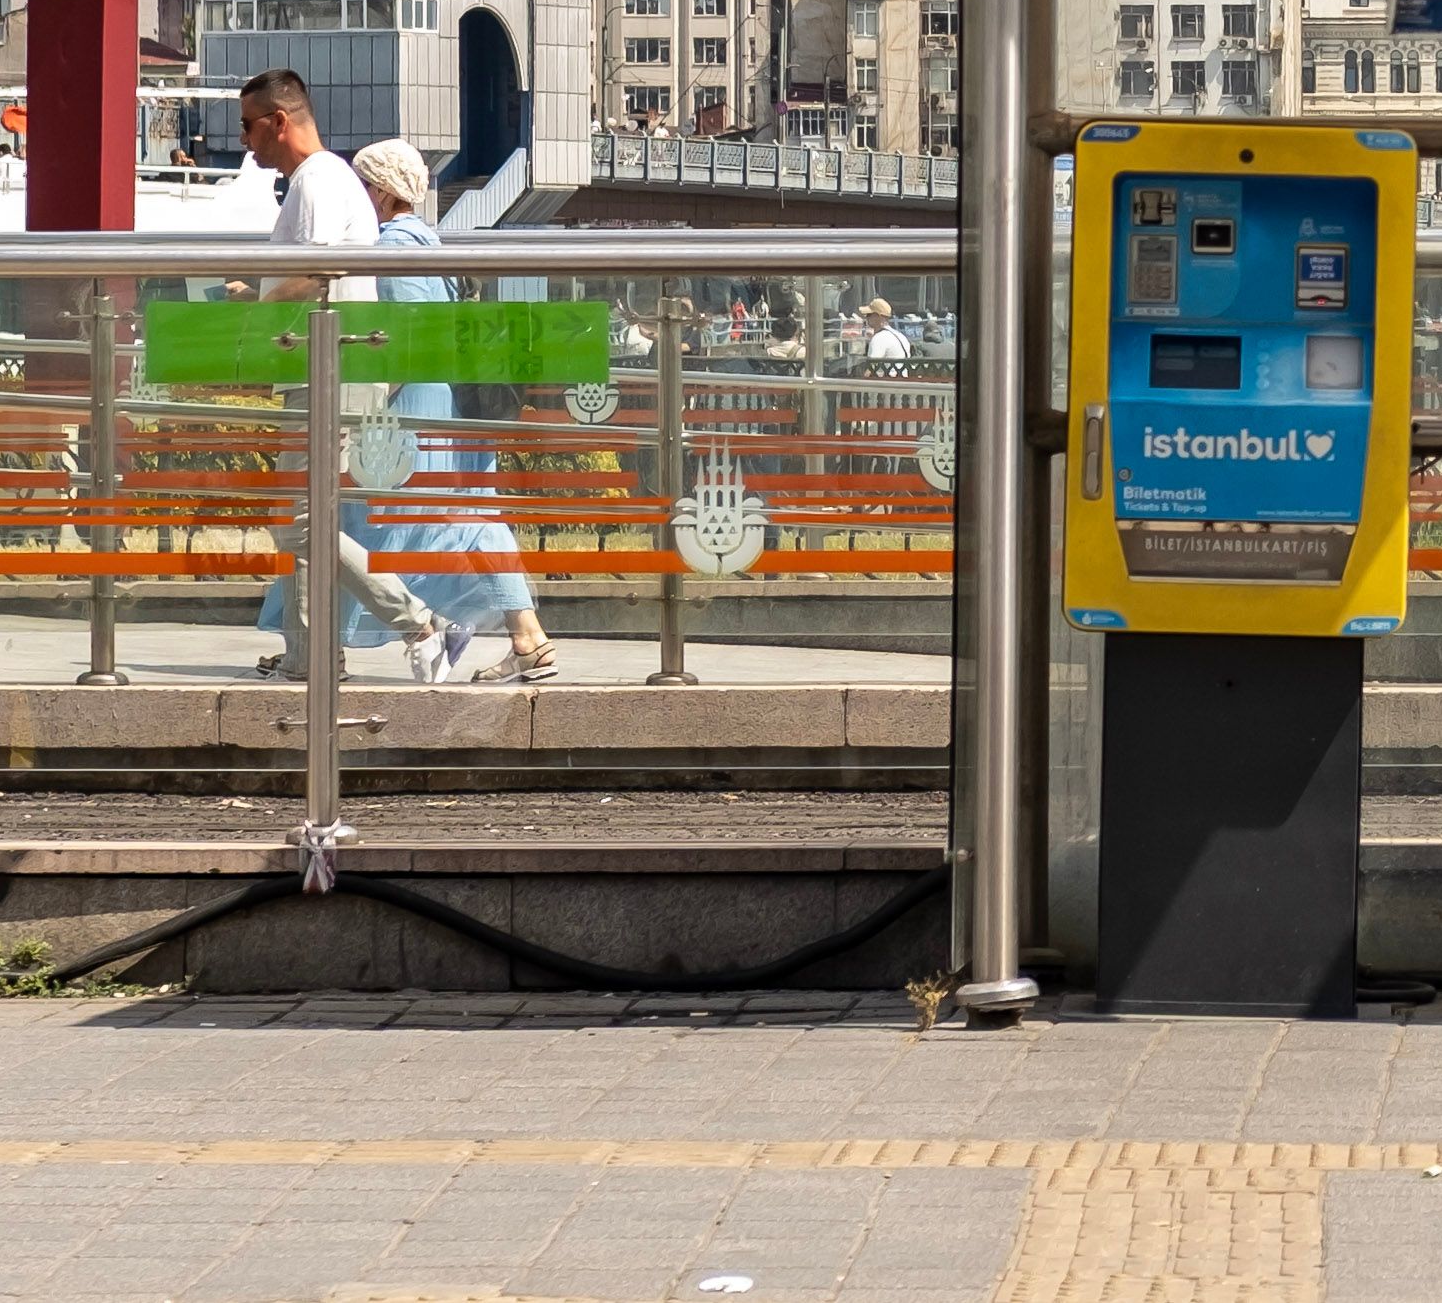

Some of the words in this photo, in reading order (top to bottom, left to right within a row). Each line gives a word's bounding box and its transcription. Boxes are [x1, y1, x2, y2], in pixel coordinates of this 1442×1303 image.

[1143, 426, 1297, 460] istanbul
[1123, 486, 1206, 500] Biletmatik
[1124, 502, 1159, 512] Tickets
[1173, 502, 1206, 514] Top-up
